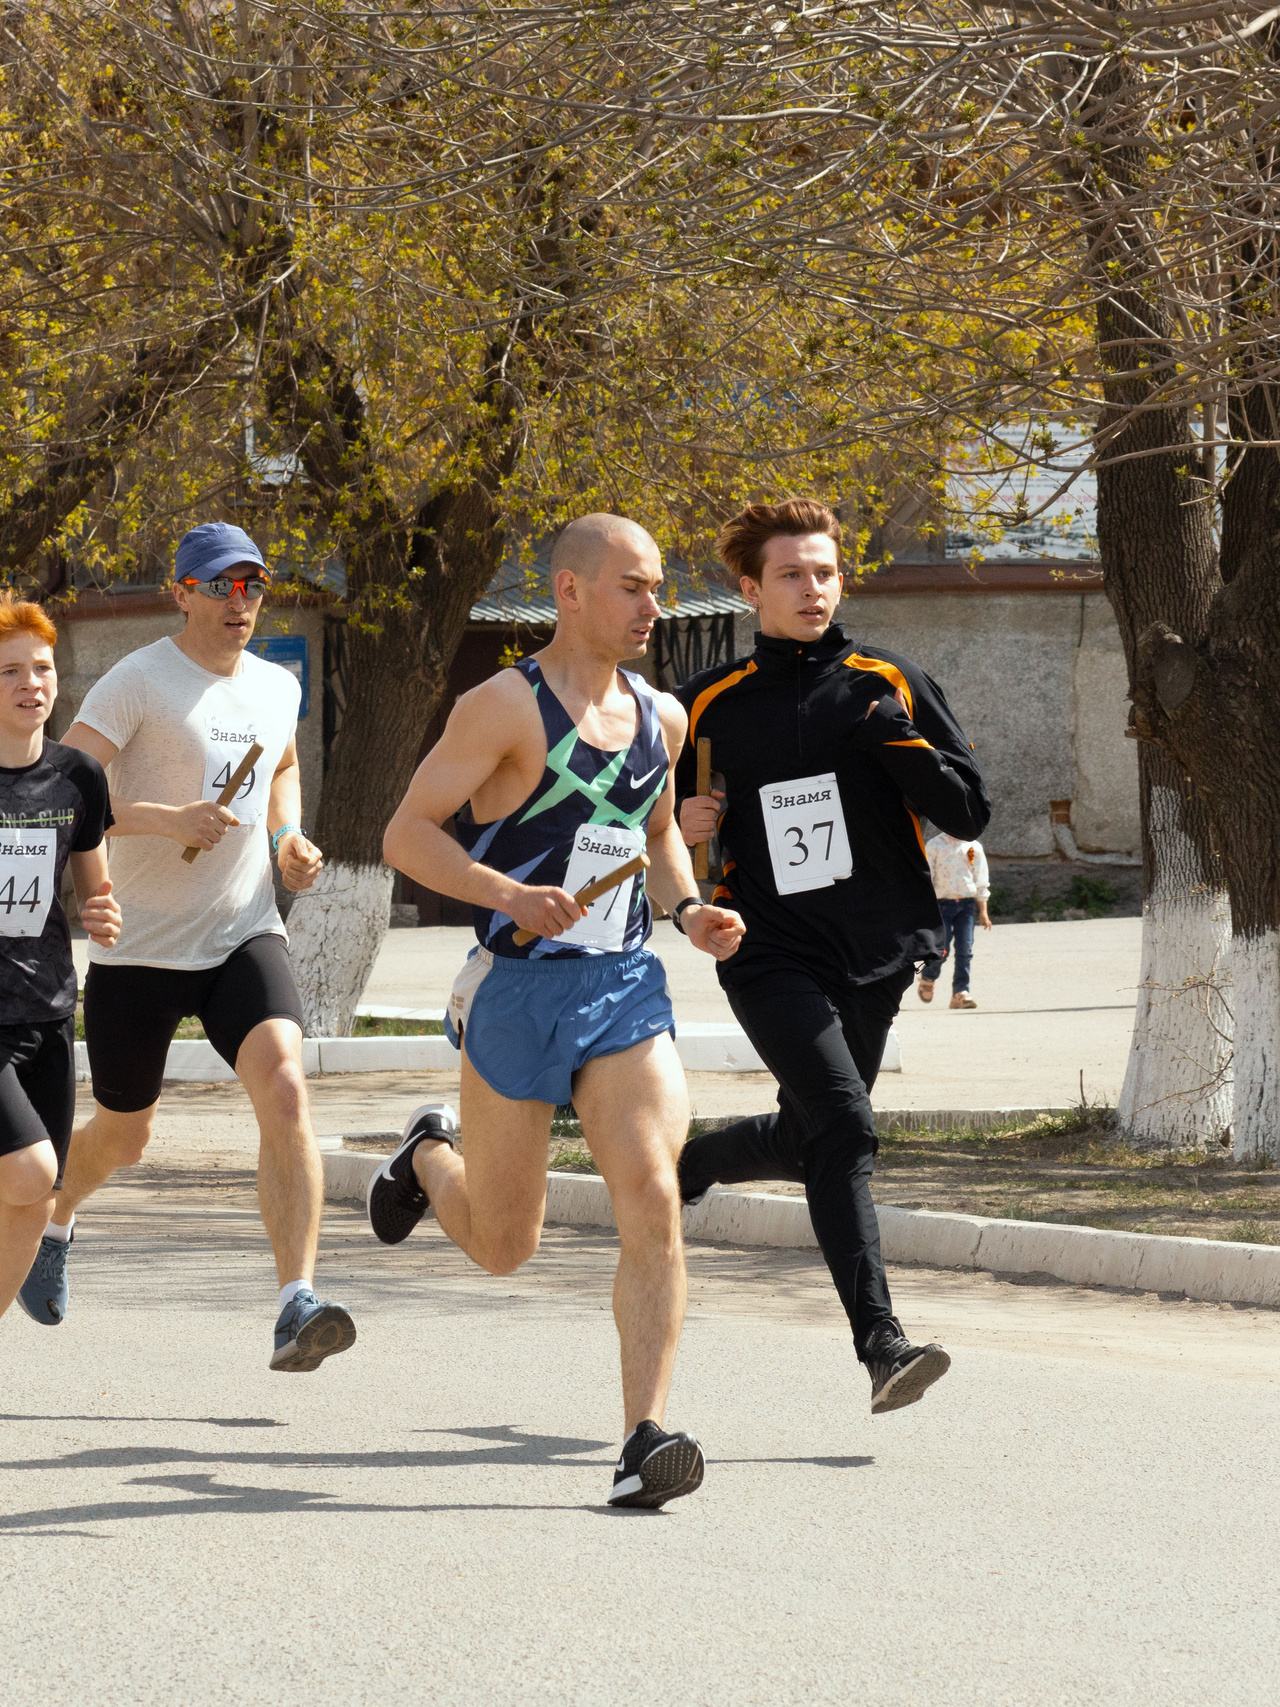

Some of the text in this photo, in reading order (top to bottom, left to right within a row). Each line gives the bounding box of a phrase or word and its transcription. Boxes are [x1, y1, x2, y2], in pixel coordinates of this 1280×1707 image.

[210, 728, 257, 743] Знамя
[771, 789, 832, 810] Знамя
[38, 808, 75, 828] CLUB
[577, 836, 632, 859] Знамя
[783, 820, 834, 867] 37
